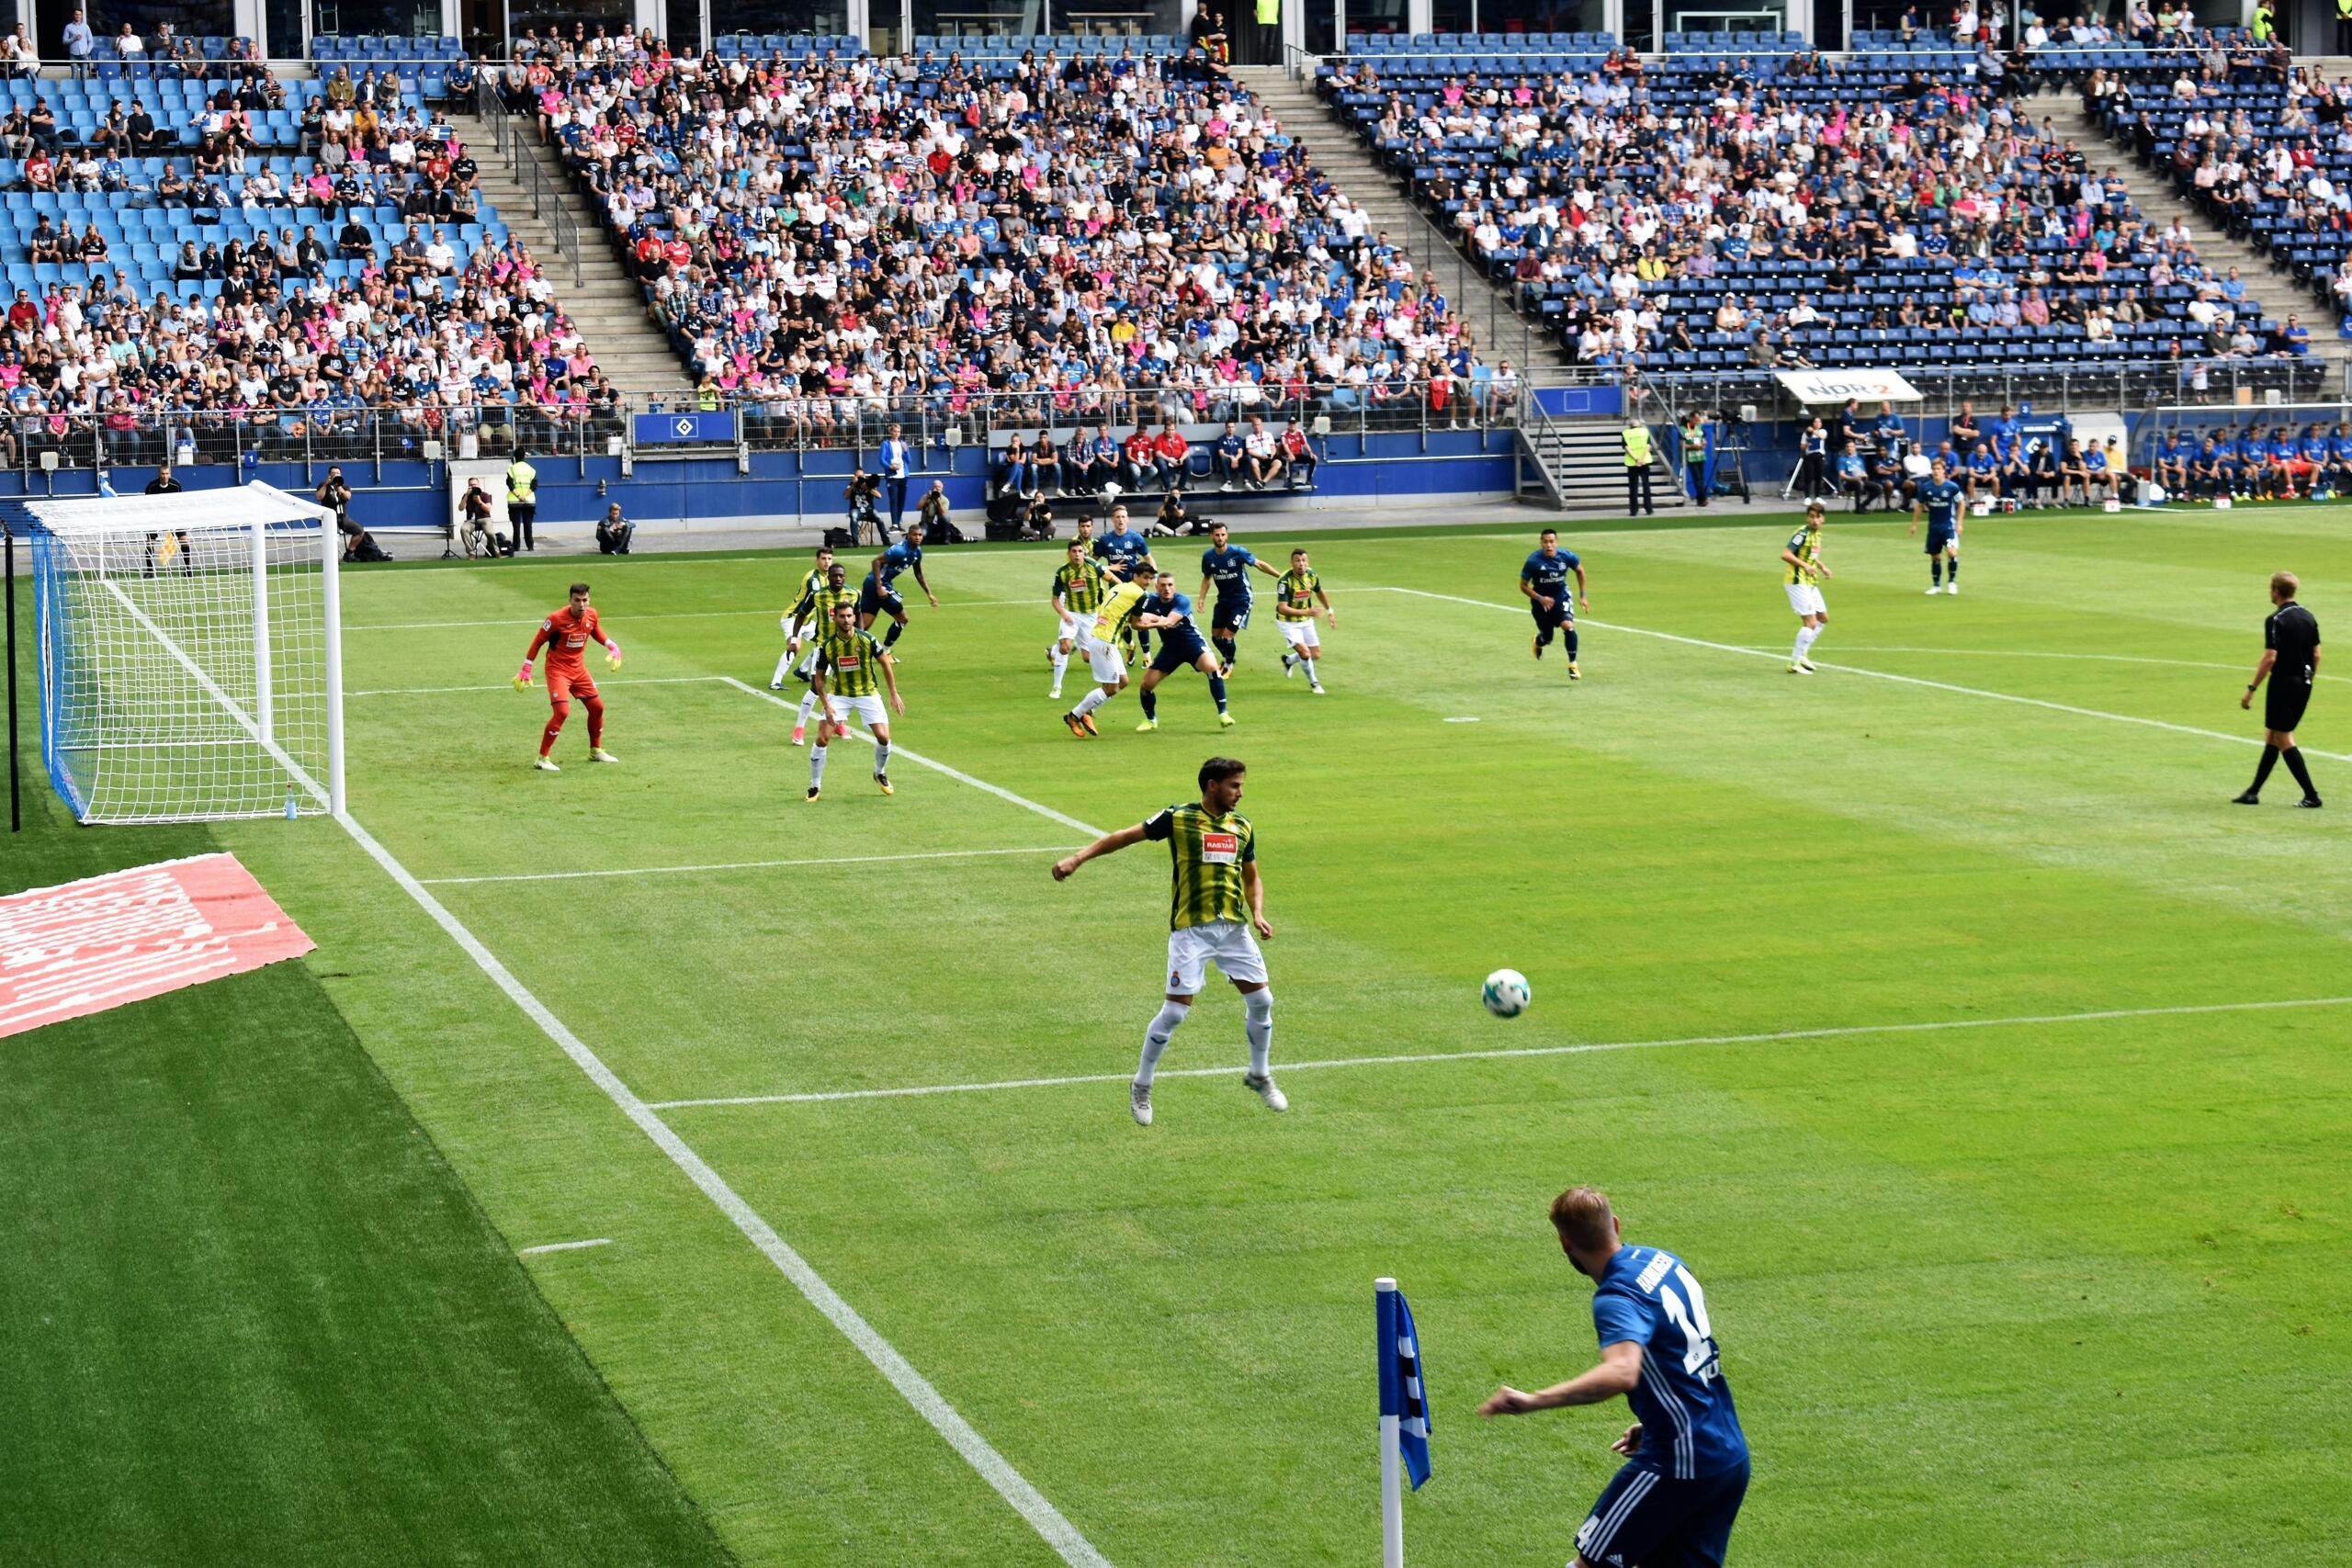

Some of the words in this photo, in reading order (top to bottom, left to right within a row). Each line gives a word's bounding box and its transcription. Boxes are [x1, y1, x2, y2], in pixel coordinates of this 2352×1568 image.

[1807, 380, 1869, 397] NDR
[1872, 384, 1894, 395] 2
[249, 455, 254, 463] 1
[1104, 591, 1118, 608] 7
[1232, 614, 1242, 626] 5
